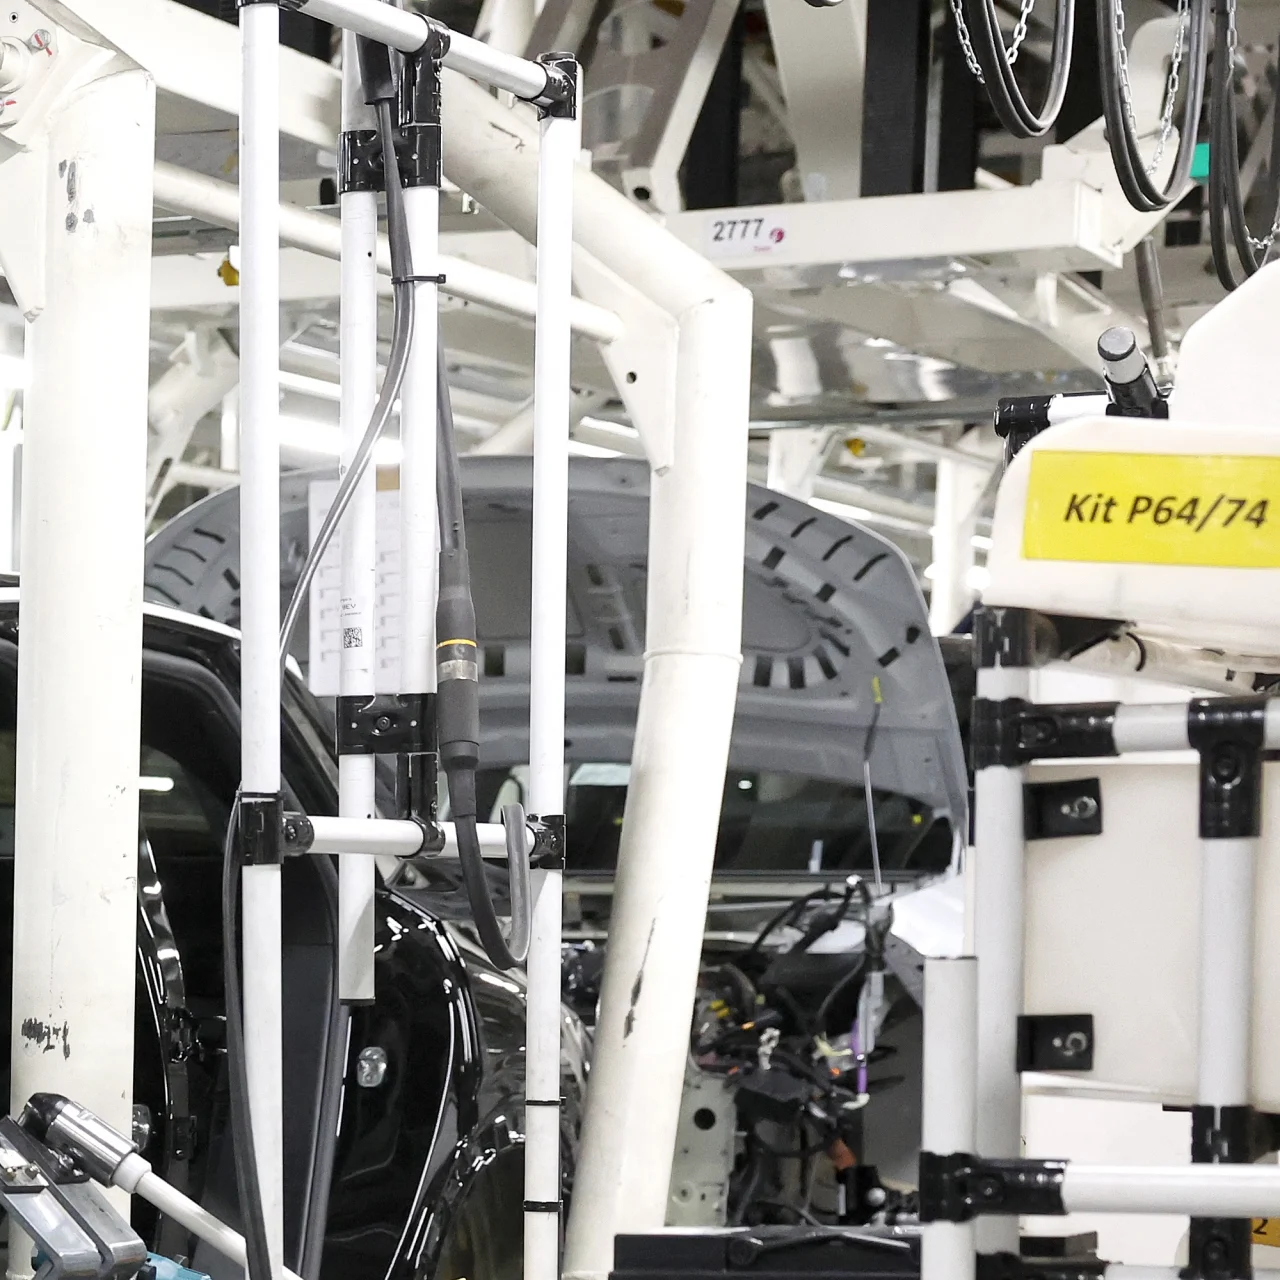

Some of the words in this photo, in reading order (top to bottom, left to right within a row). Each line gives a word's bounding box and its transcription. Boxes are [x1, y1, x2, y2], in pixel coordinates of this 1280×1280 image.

[713, 218, 764, 241] 2777
[1064, 493, 1118, 523] Kit
[1127, 493, 1269, 533] P64/74
